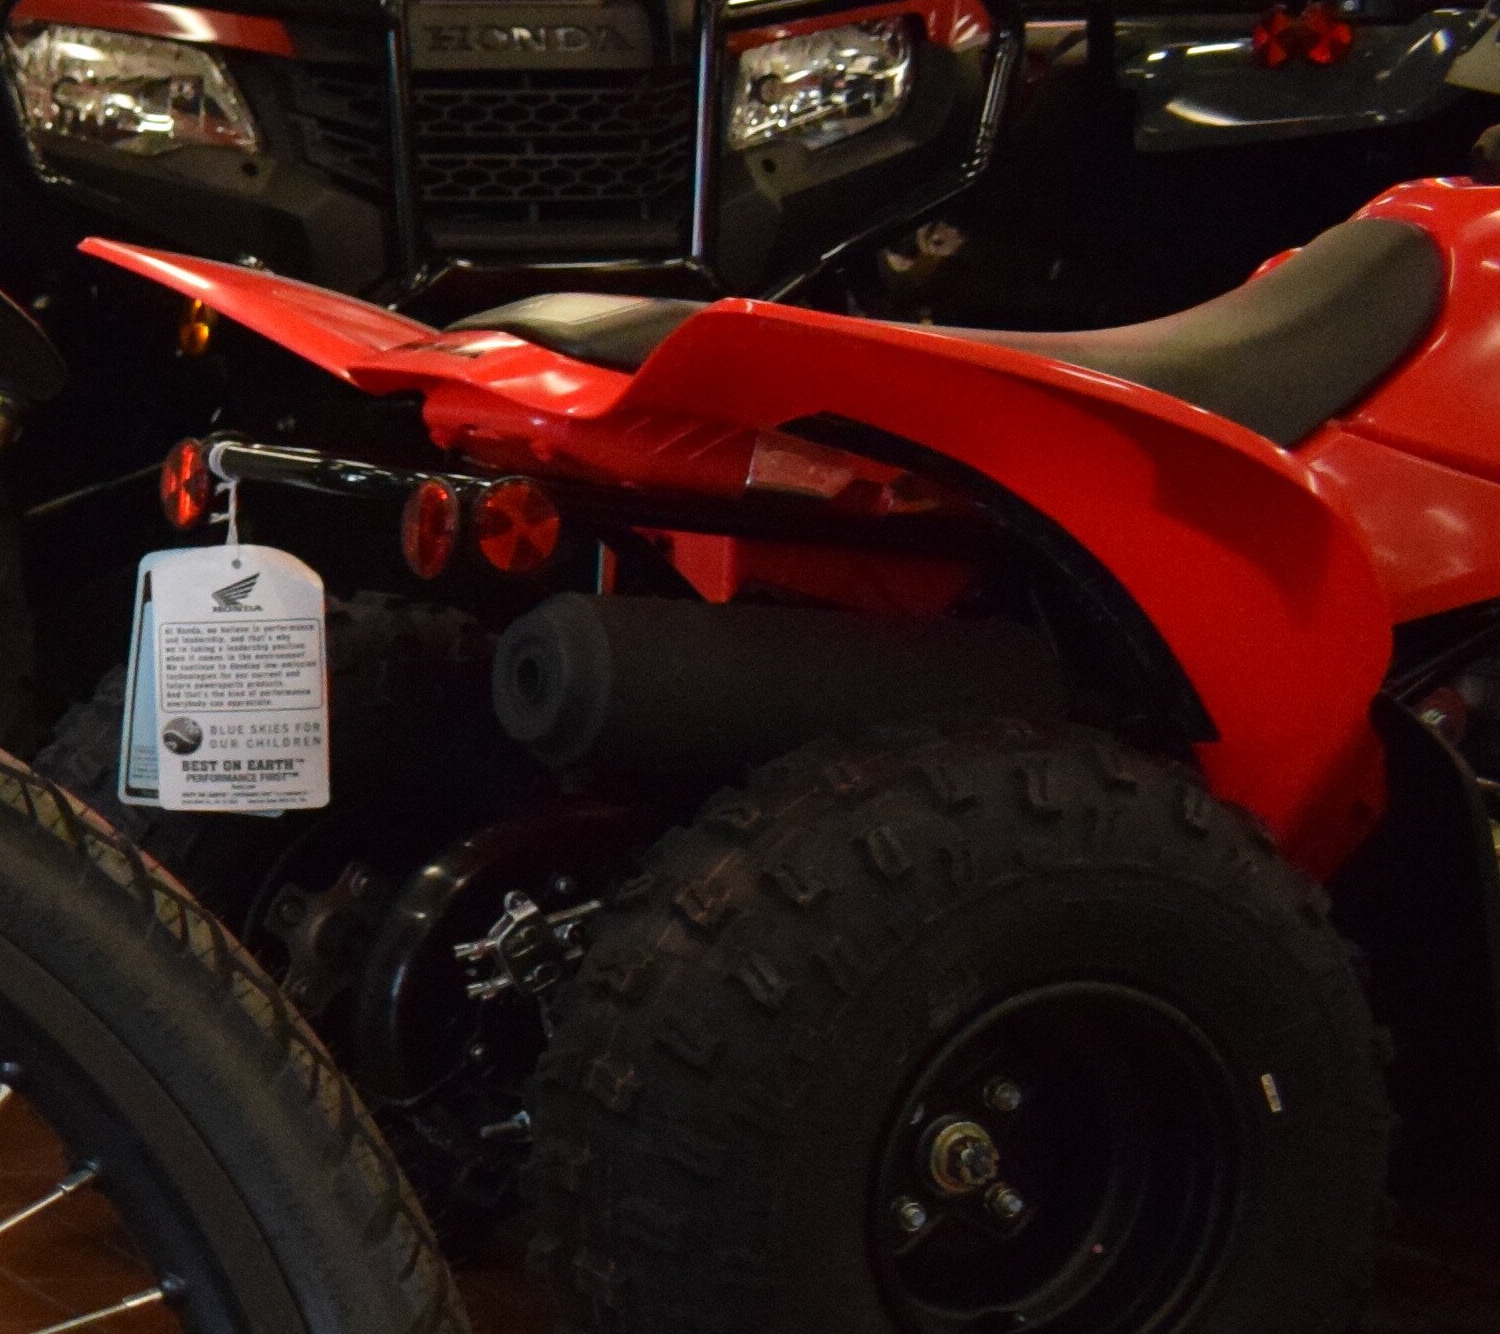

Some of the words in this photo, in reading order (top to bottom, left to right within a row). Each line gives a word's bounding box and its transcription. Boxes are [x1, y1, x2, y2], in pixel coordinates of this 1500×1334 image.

[424, 24, 638, 52] HONDA
[212, 604, 264, 613] HONDA
[209, 725, 244, 735] BLUE
[250, 724, 289, 734] SKIES
[295, 722, 321, 732] FOR
[209, 739, 239, 749] OUR
[246, 737, 321, 748] CHILDREN
[182, 760, 217, 772] BEST
[222, 760, 242, 771] ON
[186, 773, 257, 782] PERFORMANCE
